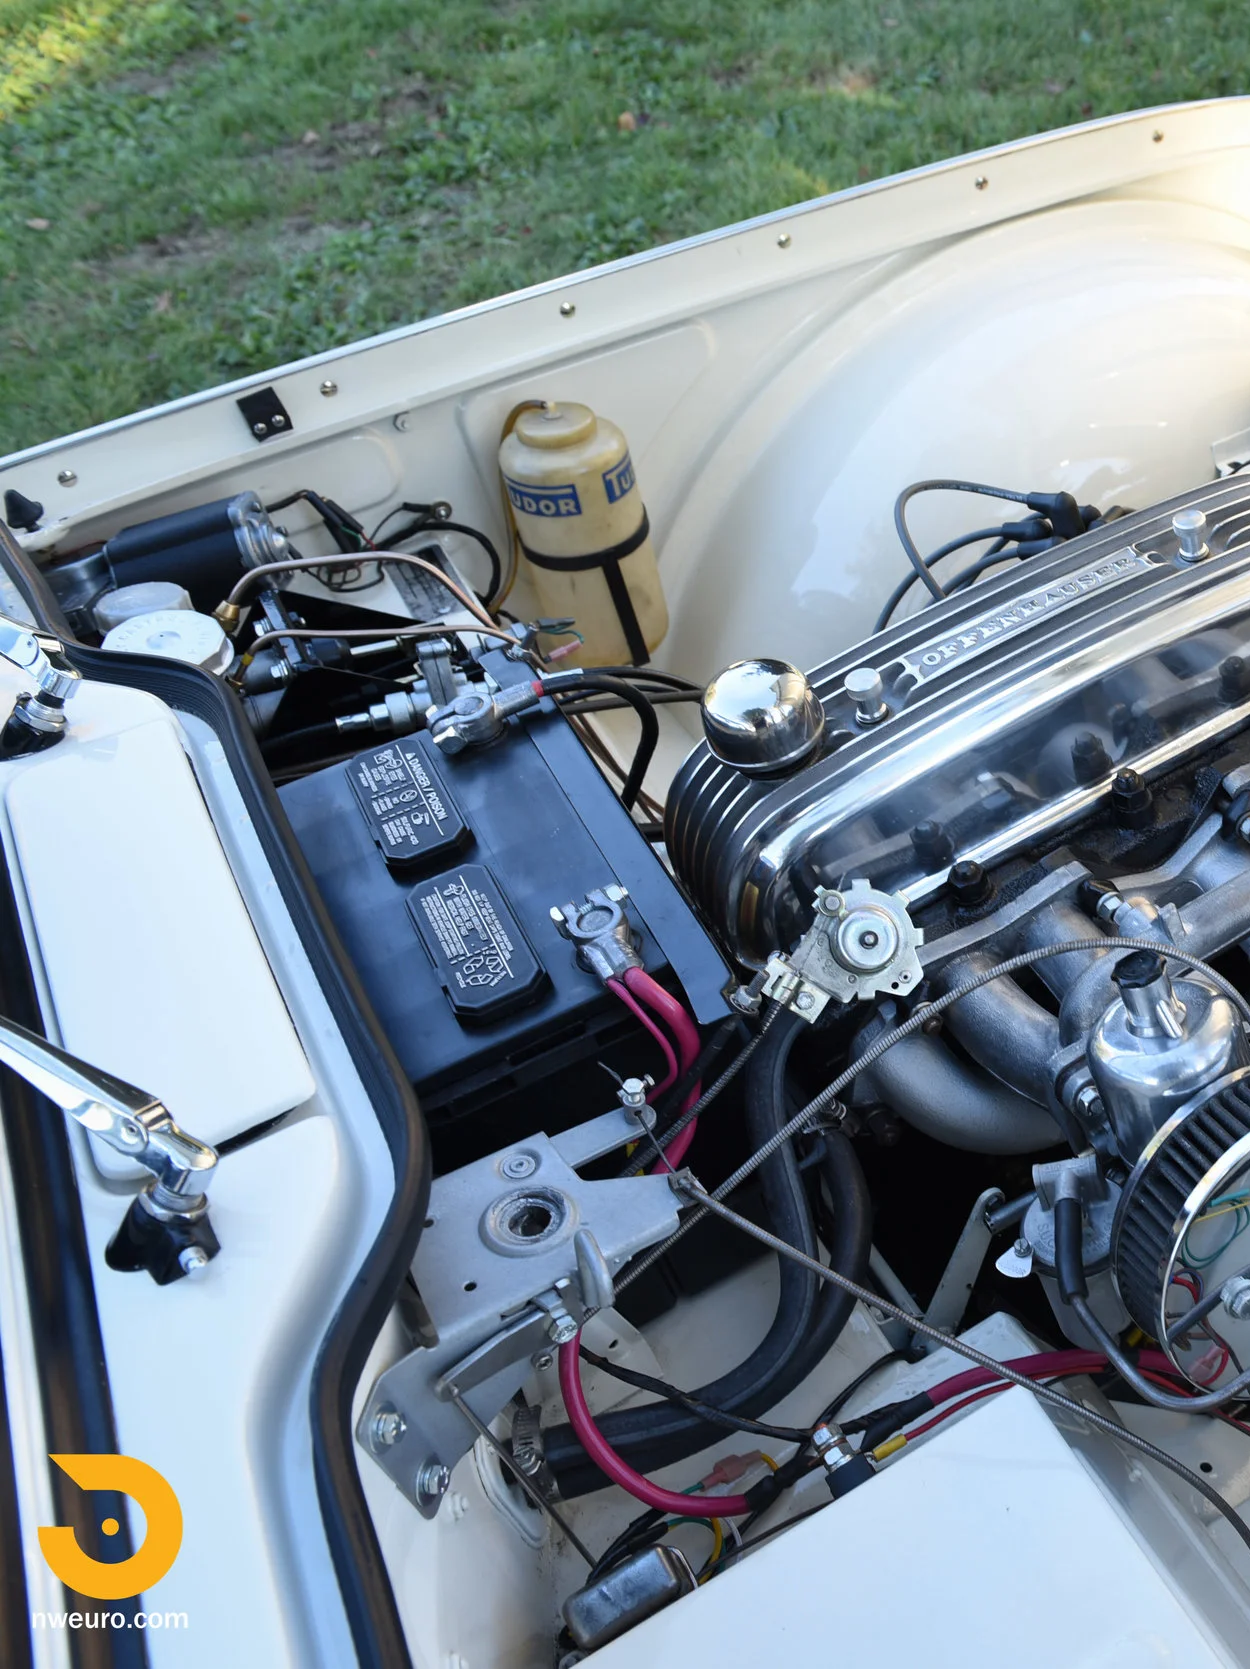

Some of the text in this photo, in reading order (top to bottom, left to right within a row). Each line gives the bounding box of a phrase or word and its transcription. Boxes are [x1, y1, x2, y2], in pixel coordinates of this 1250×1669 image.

[506, 485, 578, 516] UDOR
[920, 556, 1138, 668] OFFENHAUSER
[408, 757, 431, 788] DANGER
[425, 790, 448, 820] POISON
